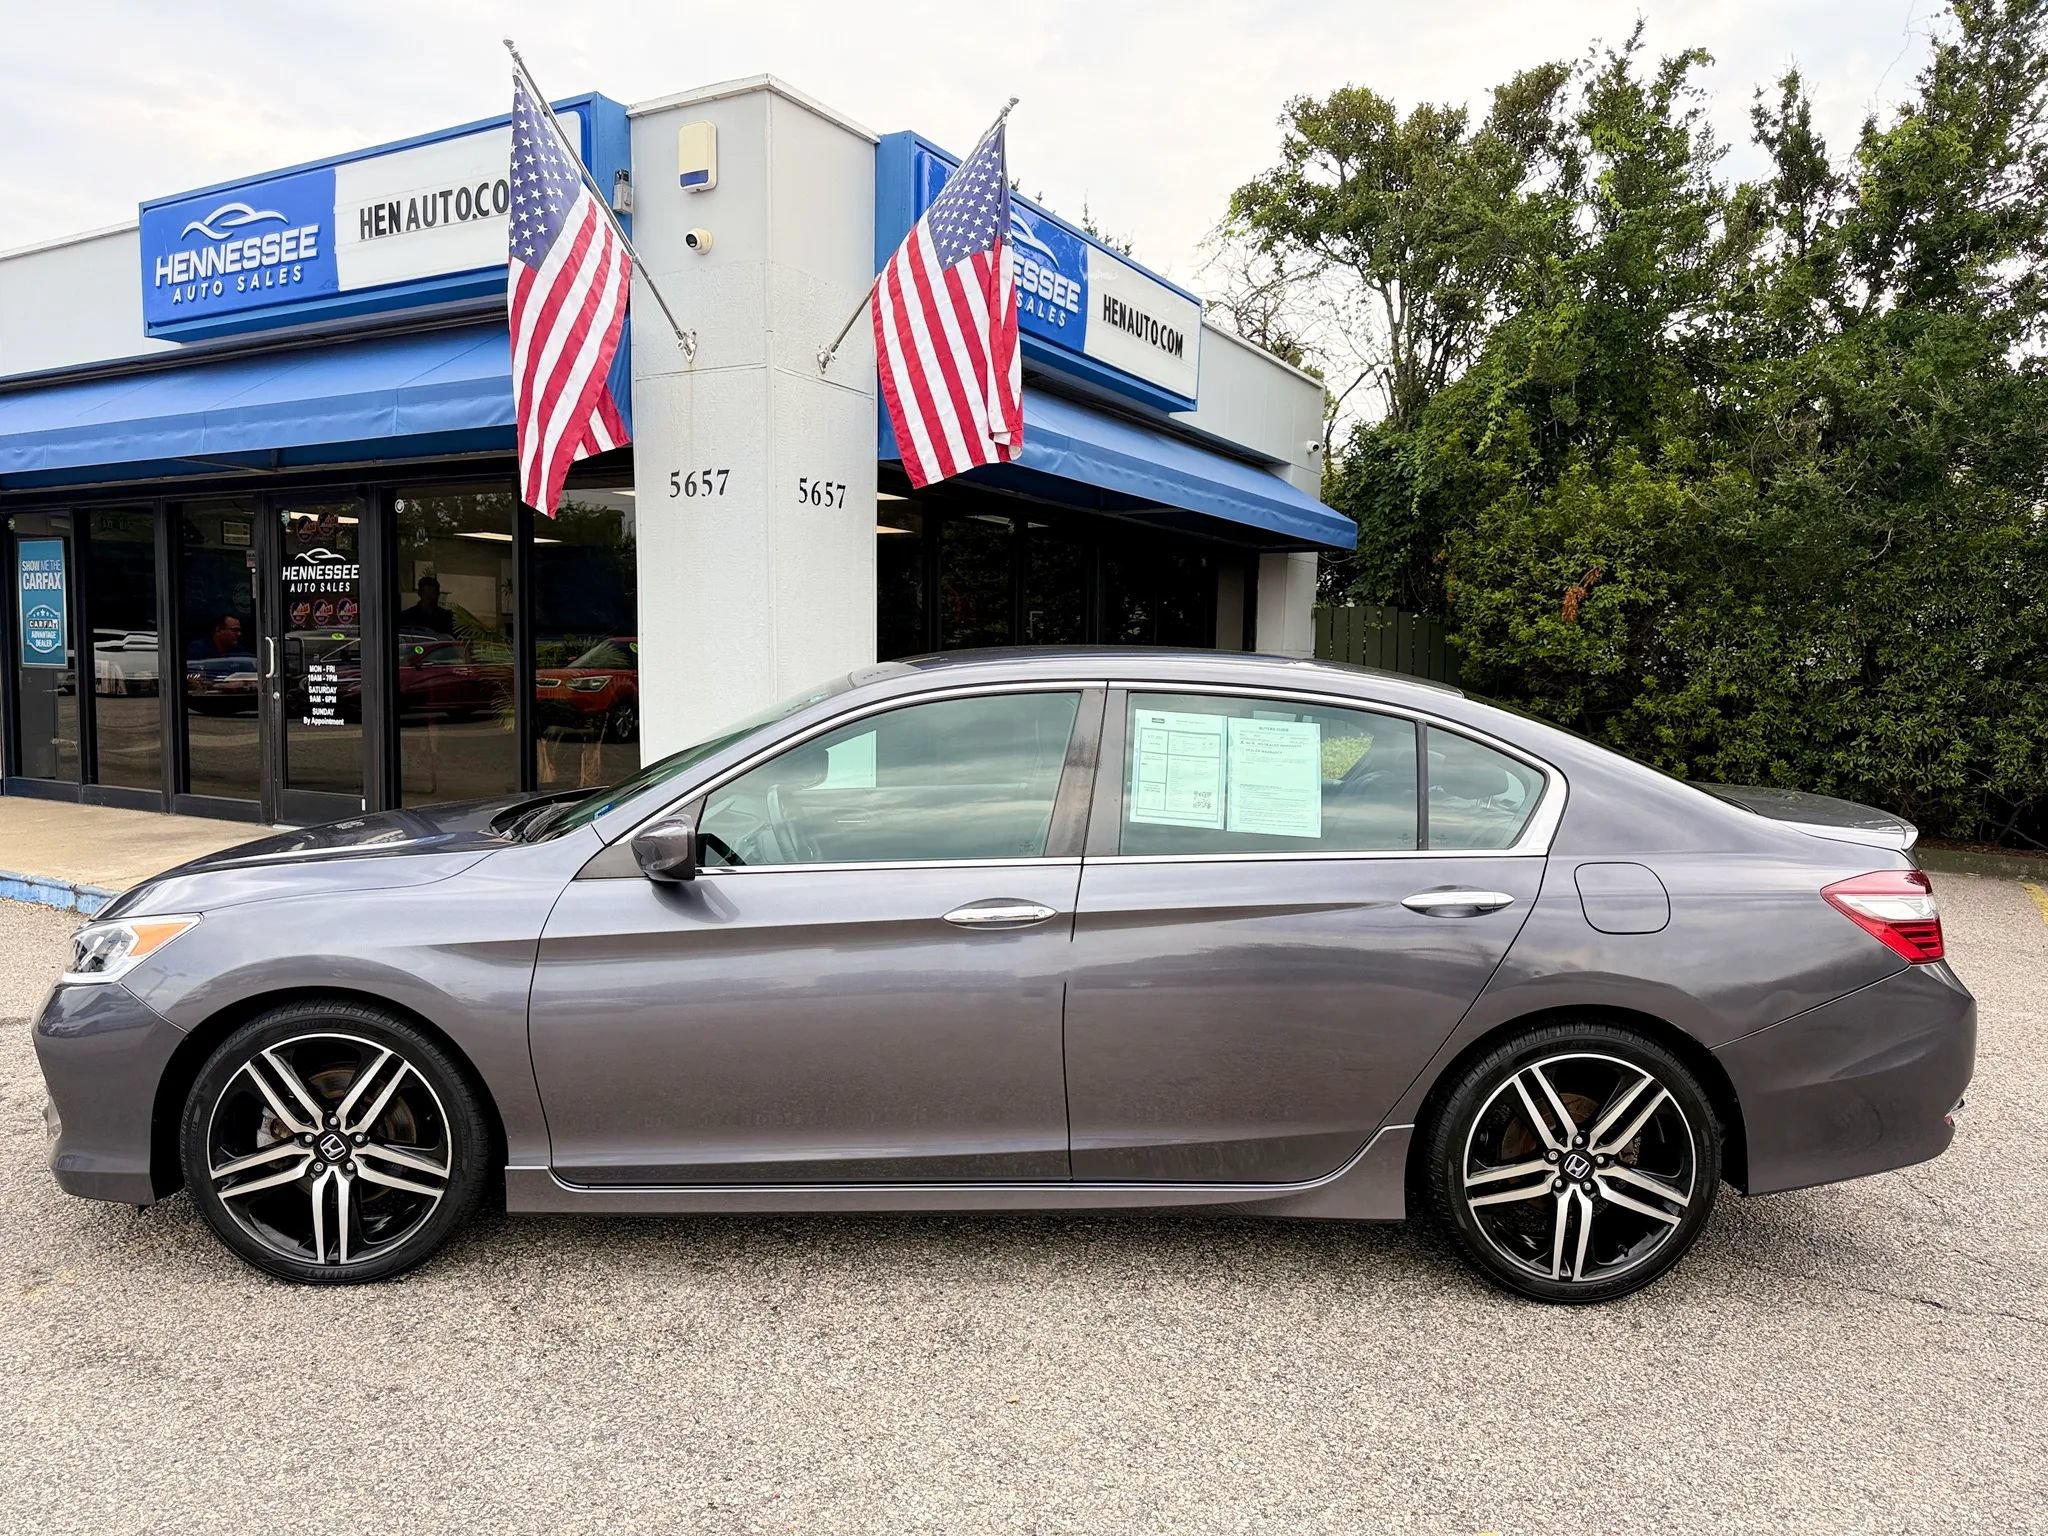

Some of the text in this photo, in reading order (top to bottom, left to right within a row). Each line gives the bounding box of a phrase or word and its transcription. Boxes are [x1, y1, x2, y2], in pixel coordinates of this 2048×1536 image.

[359, 178, 511, 240] HENAUTO.CO
[154, 224, 319, 288] HENNESSEE
[172, 265, 302, 305] AUTO SALES
[1013, 252, 1081, 314] ESSEE
[1015, 289, 1067, 328] SALES
[669, 468, 730, 498] 5657
[798, 477, 847, 509] 5657
[22, 560, 61, 572] SHOW ME THE
[282, 564, 360, 581] HENNESSEE
[23, 572, 62, 590] CARFAX
[290, 581, 351, 593] AUTO SALES
[31, 630, 57, 639] ADVANTAGE
[35, 639, 53, 647] DEALER
[308, 686, 338, 694] SATURDAY
[312, 707, 335, 716] SUNDAY
[303, 716, 345, 726] By Appointment
